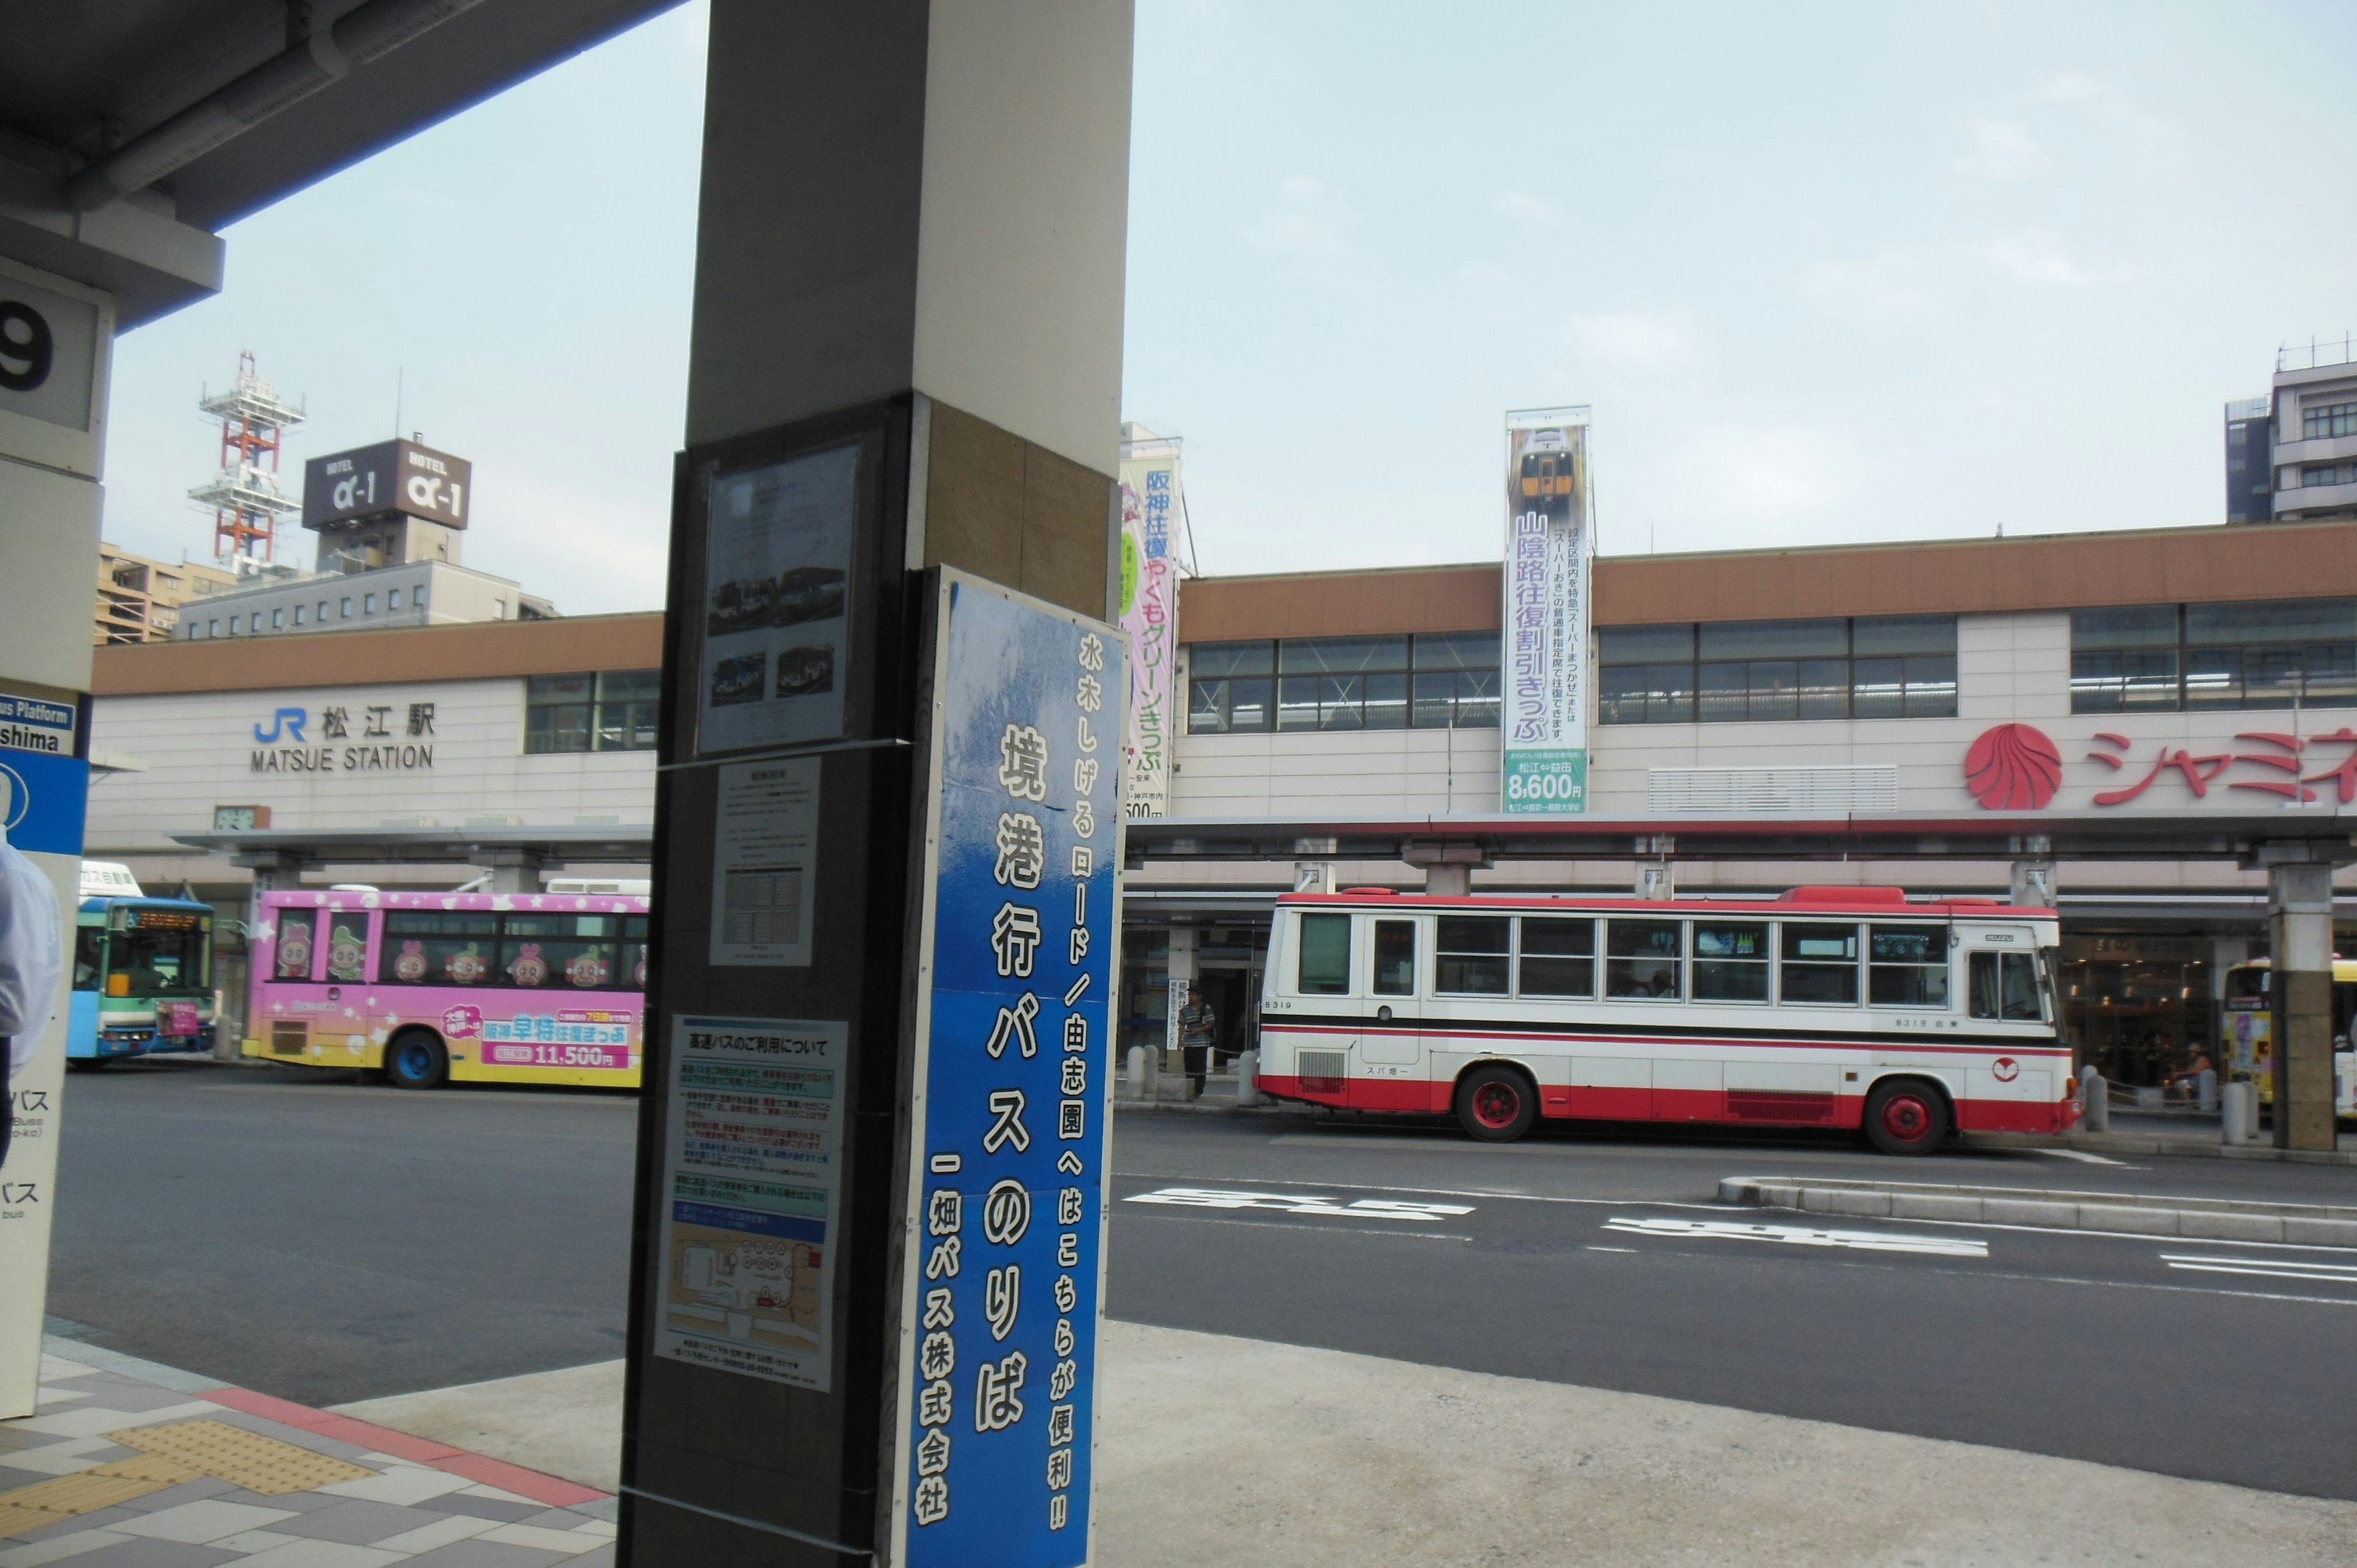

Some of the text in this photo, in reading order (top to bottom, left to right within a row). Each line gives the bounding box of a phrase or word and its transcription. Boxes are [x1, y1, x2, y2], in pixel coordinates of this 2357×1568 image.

[0, 301, 53, 392] 9
[327, 460, 353, 475] HOTEL
[409, 452, 447, 475] HOTEL
[1515, 512, 1548, 741] 山陰路往復割引きっぷ
[17, 701, 68, 724] Platform
[254, 703, 435, 743] JR 松江駅
[0, 724, 58, 751] shima
[251, 746, 433, 772] MATSUE STATION
[1509, 774, 1581, 799] 8,600円
[689, 1033, 829, 1056] 高速バスのご利用について
[975, 725, 1047, 1432] 境港行バスのりば
[915, 1154, 962, 1526] 一畑バス株式会社
